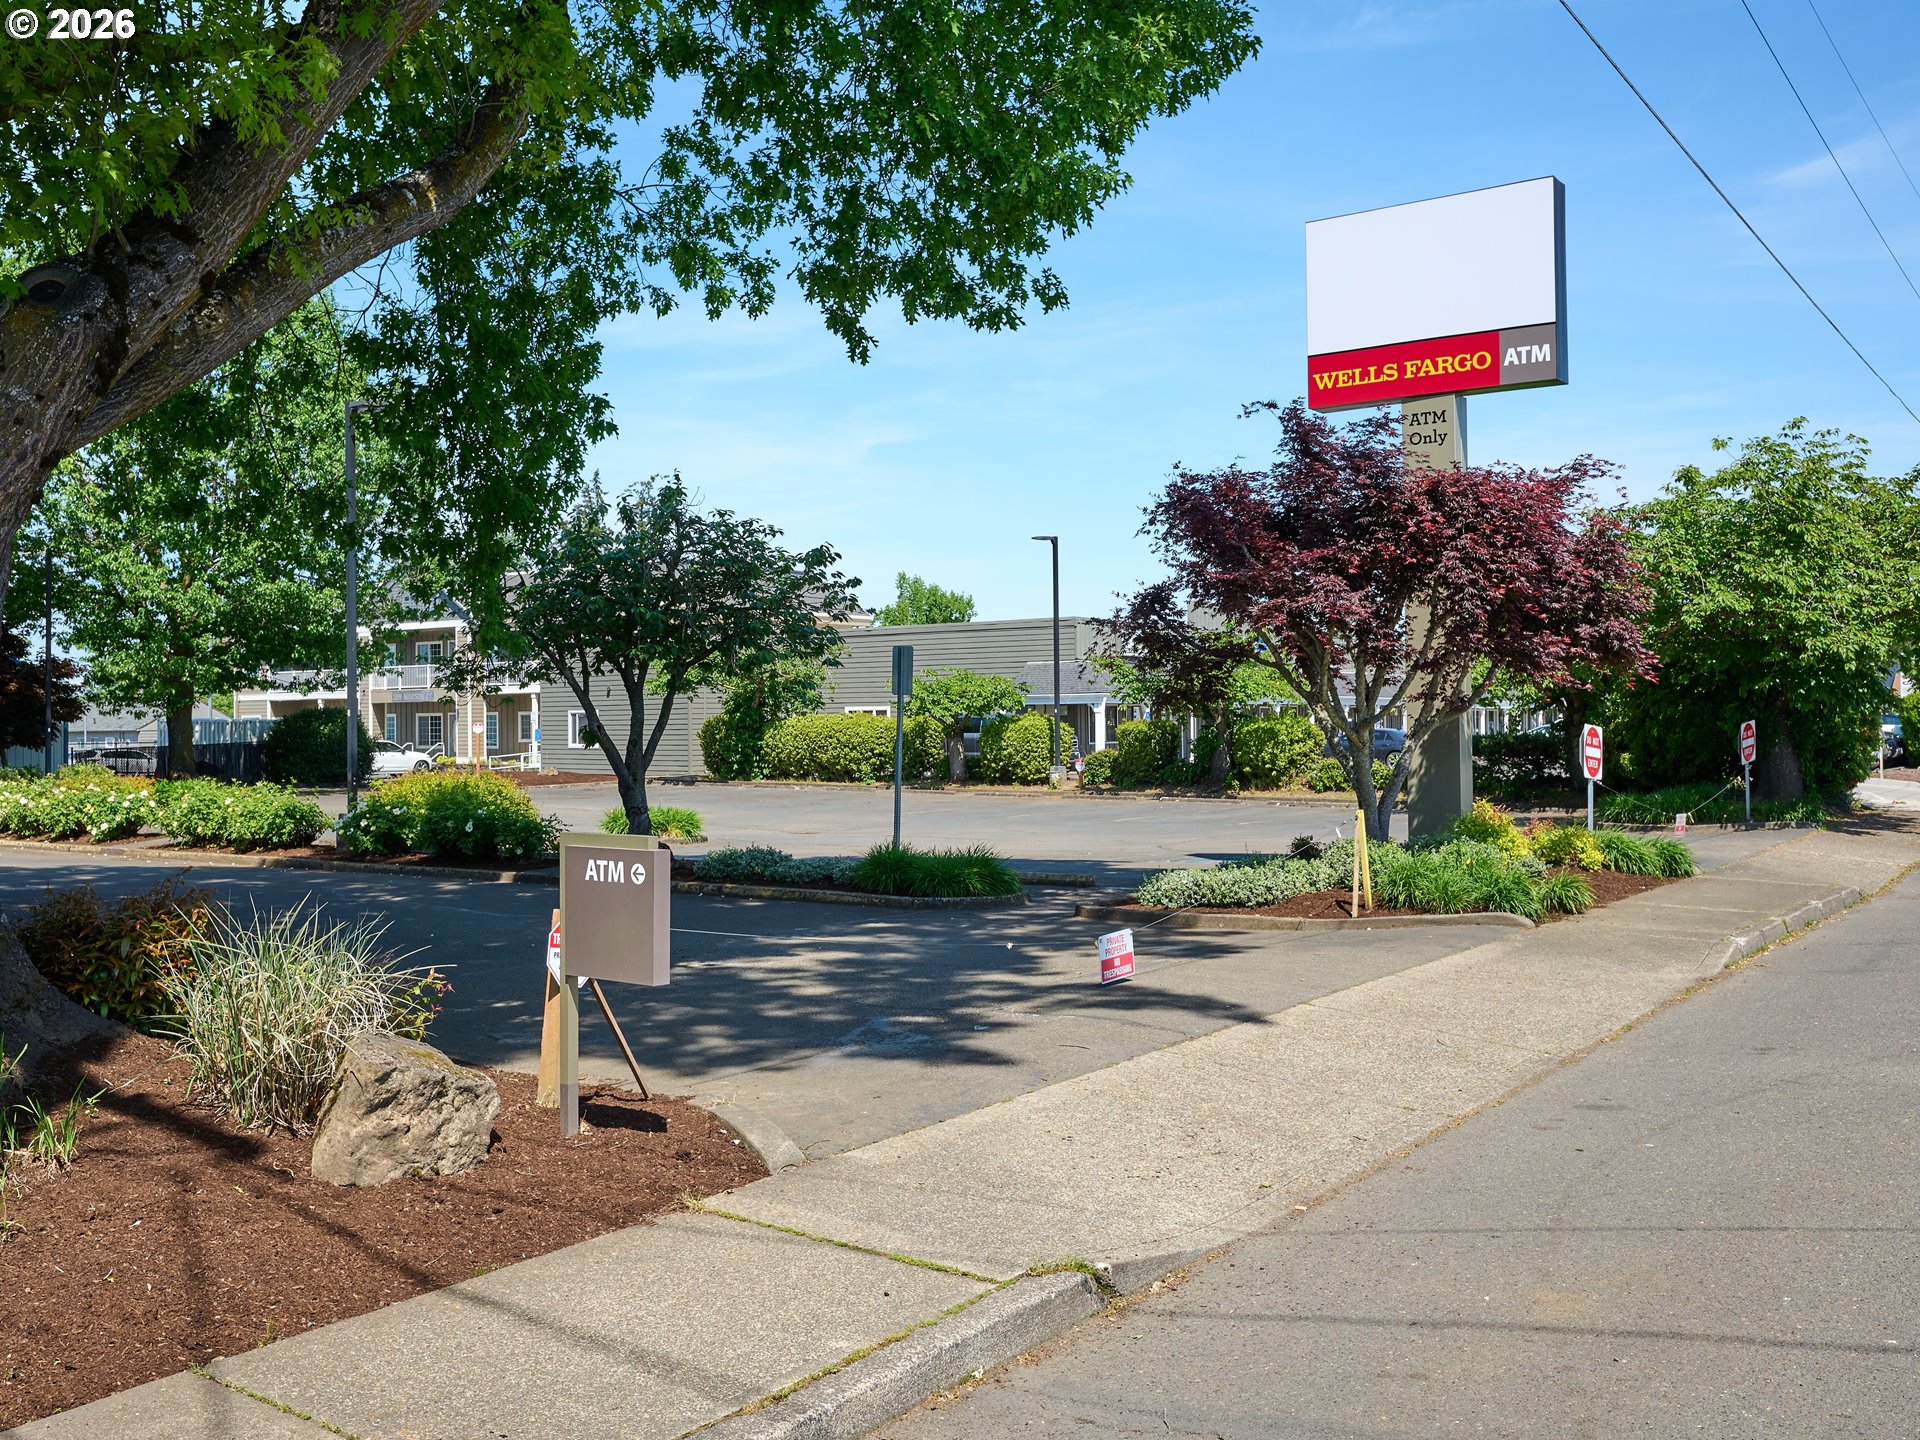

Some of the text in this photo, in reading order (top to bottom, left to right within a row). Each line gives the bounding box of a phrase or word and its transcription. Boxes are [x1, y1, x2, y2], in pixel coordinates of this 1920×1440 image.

[1503, 344, 1551, 366] ATM
[1313, 351, 1492, 390] WELLS FARGO
[1409, 409, 1447, 426] ATM
[1410, 429, 1448, 446] Only
[1592, 737, 1600, 747] NOT
[1587, 758, 1599, 769] ENTER
[585, 859, 625, 884] ATM
[1106, 934, 1125, 947] PRIVATE
[1104, 943, 1128, 957] PROPERTY
[1113, 957, 1121, 967] NO
[1103, 963, 1132, 980] TRESPASSING
